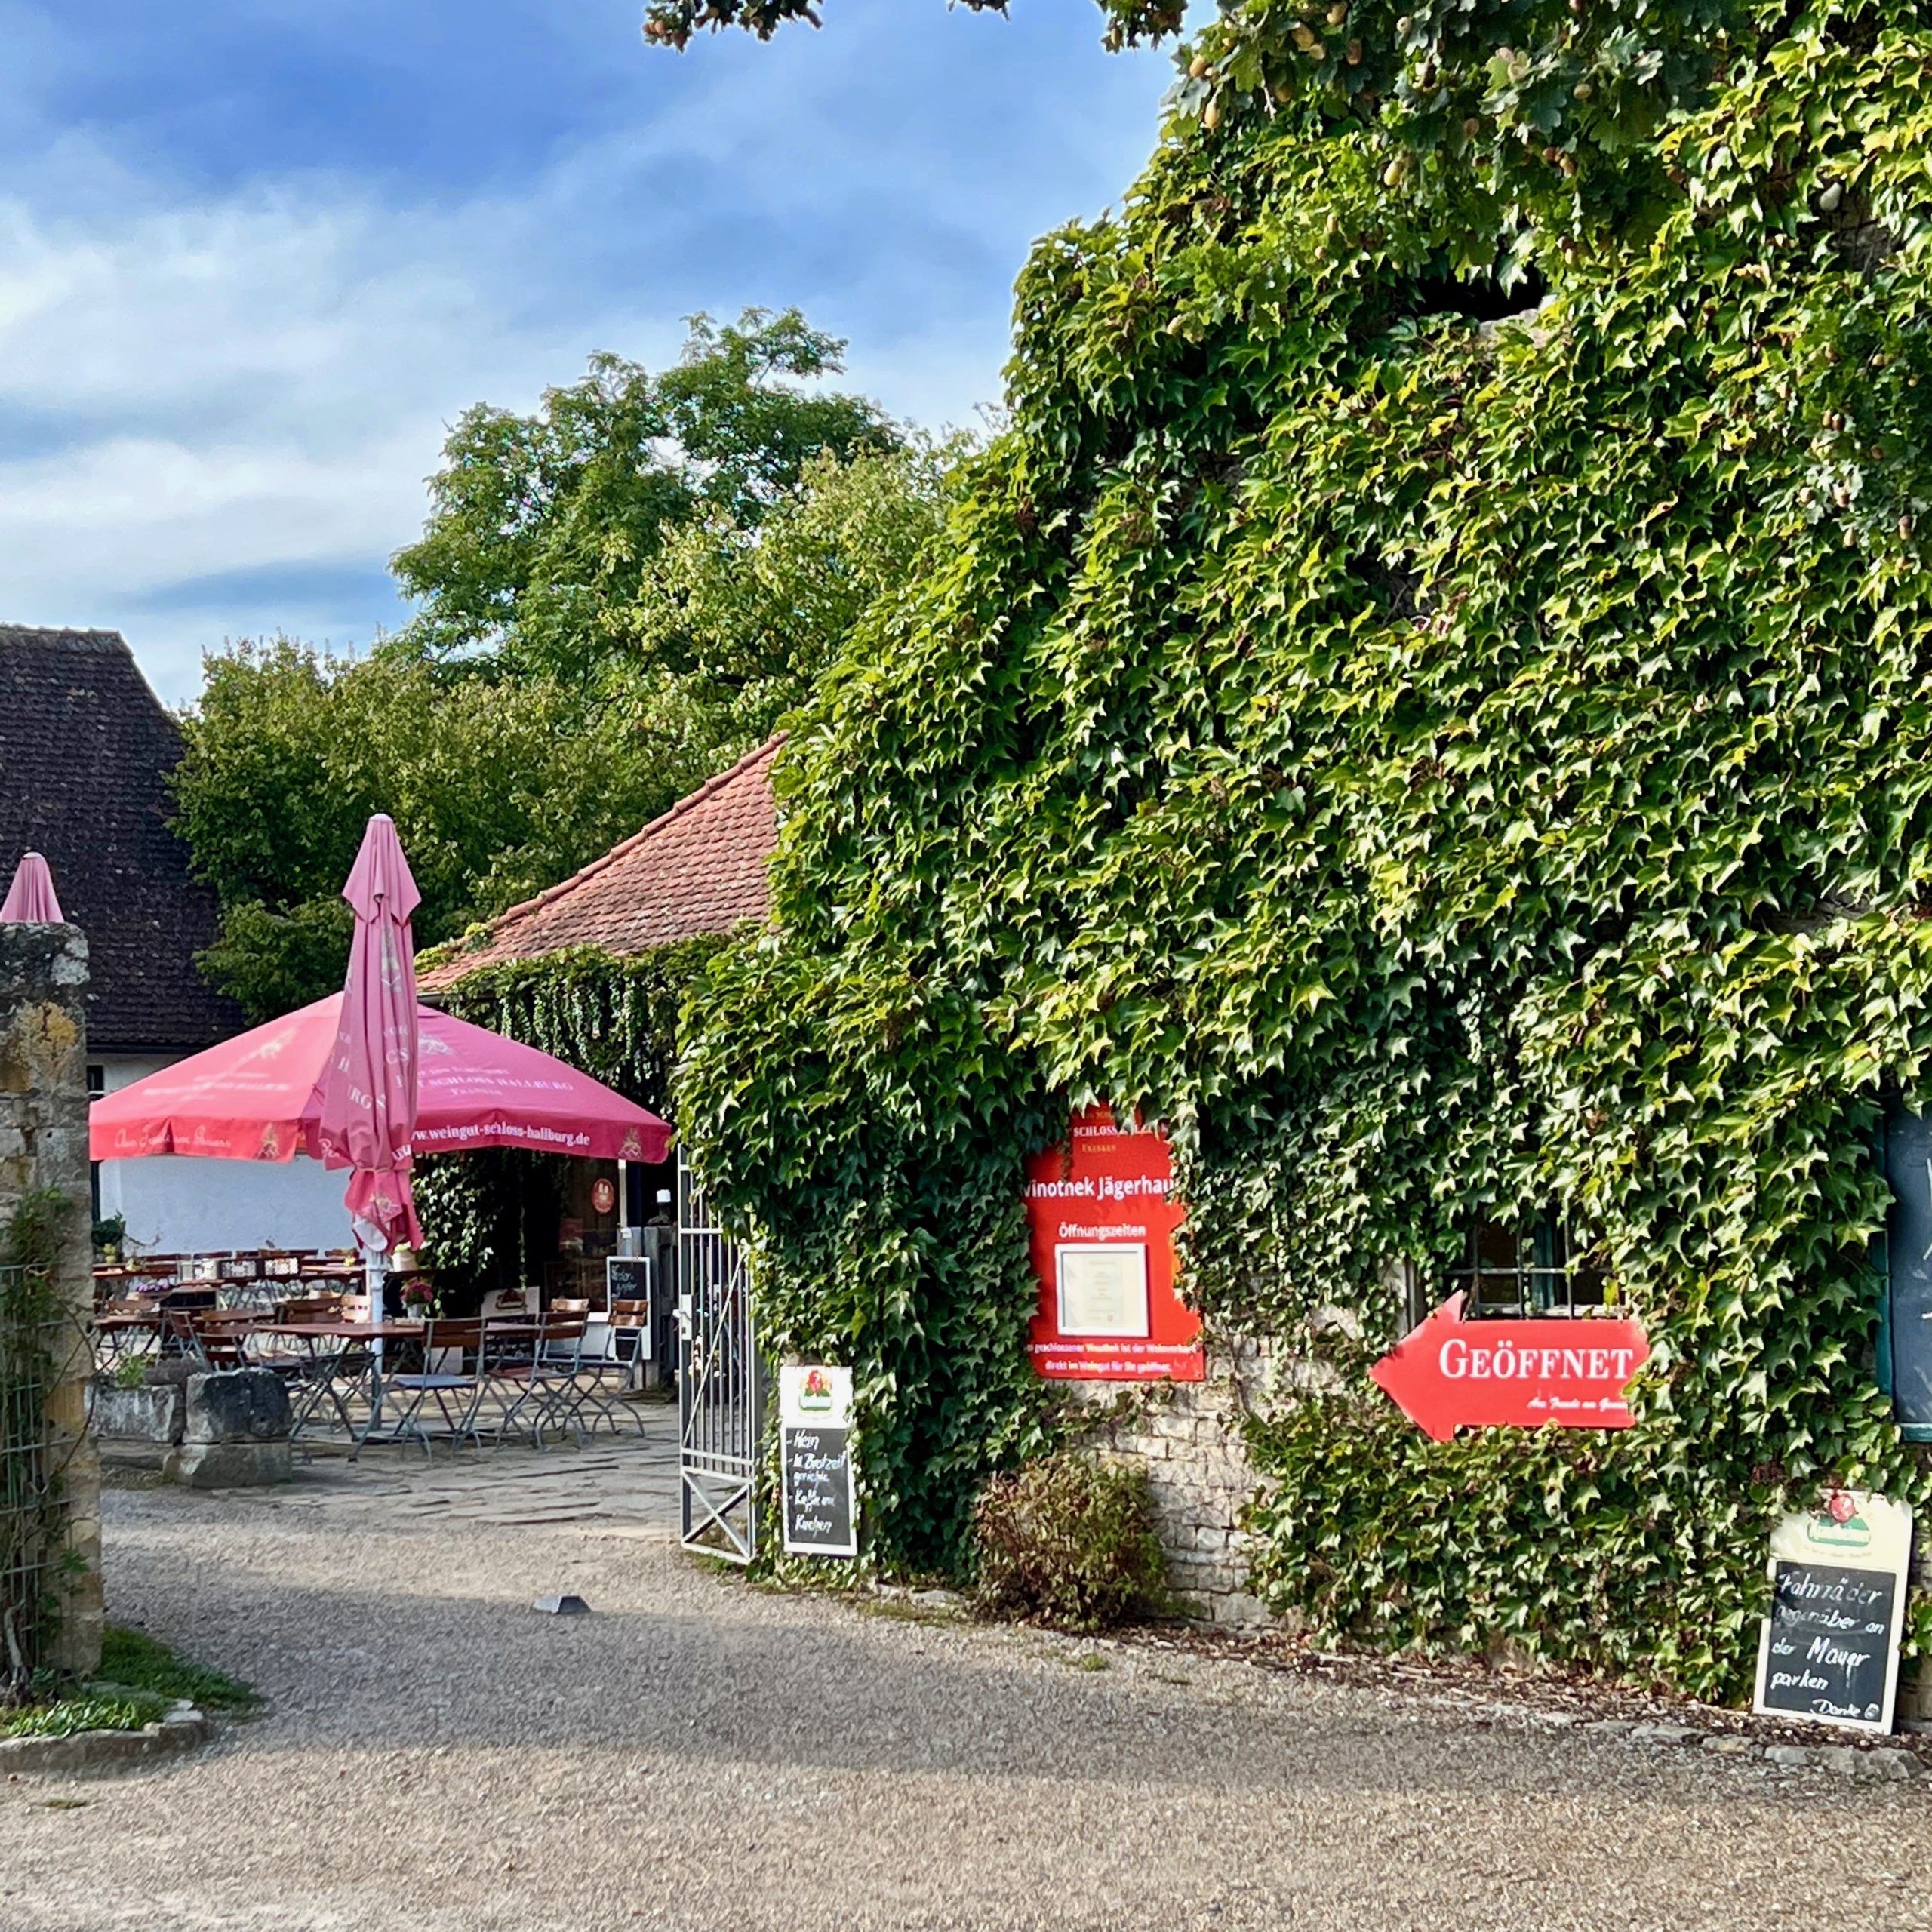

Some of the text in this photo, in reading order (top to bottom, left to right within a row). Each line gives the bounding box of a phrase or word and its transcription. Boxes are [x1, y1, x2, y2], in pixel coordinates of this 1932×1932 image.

[411, 1121, 591, 1147] w.weingut-schloss-hallburg.de
[1073, 1124, 1118, 1137] SCHLOSS
[1096, 1174, 1175, 1201] Jägerhau
[1058, 1221, 1146, 1241] Öffnungszeiten
[1439, 1339, 1634, 1380] GEÖFFNET
[1864, 1621, 1887, 1635] an
[1770, 1636, 1798, 1656] der
[1769, 1668, 1829, 1691] parken
[1810, 1699, 1861, 1718] Danke
